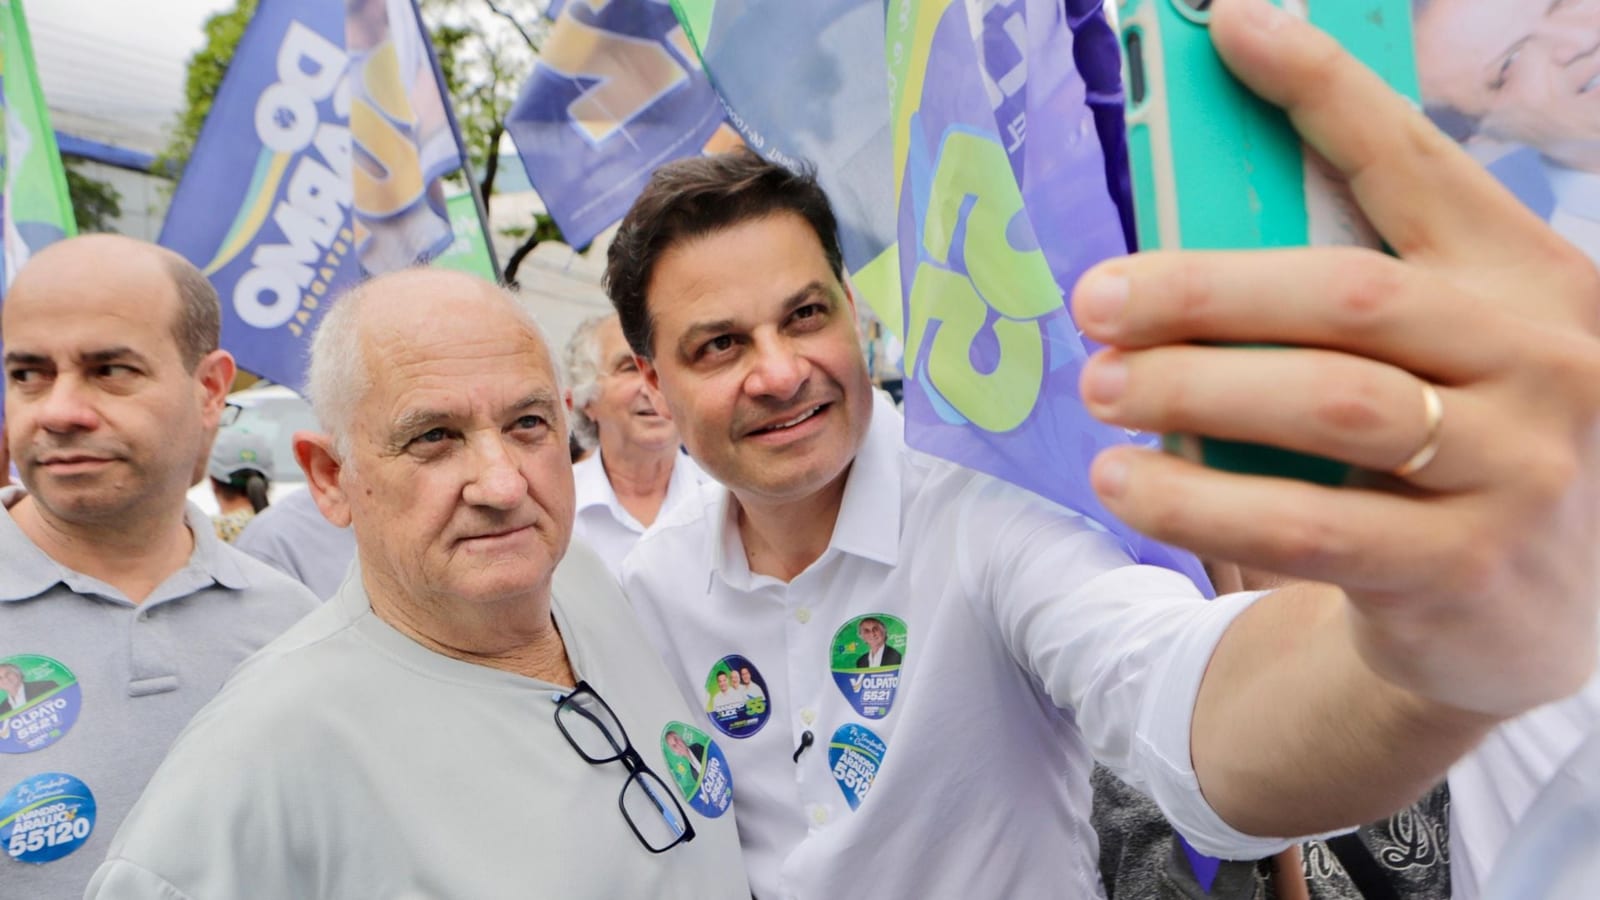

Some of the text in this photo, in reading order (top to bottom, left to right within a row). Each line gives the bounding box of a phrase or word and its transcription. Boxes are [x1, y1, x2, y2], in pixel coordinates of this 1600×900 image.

[850, 673, 898, 693] VOLPATO
[862, 690, 891, 702] 5521
[832, 761, 872, 803] 5512
[8, 817, 91, 857] 55120
